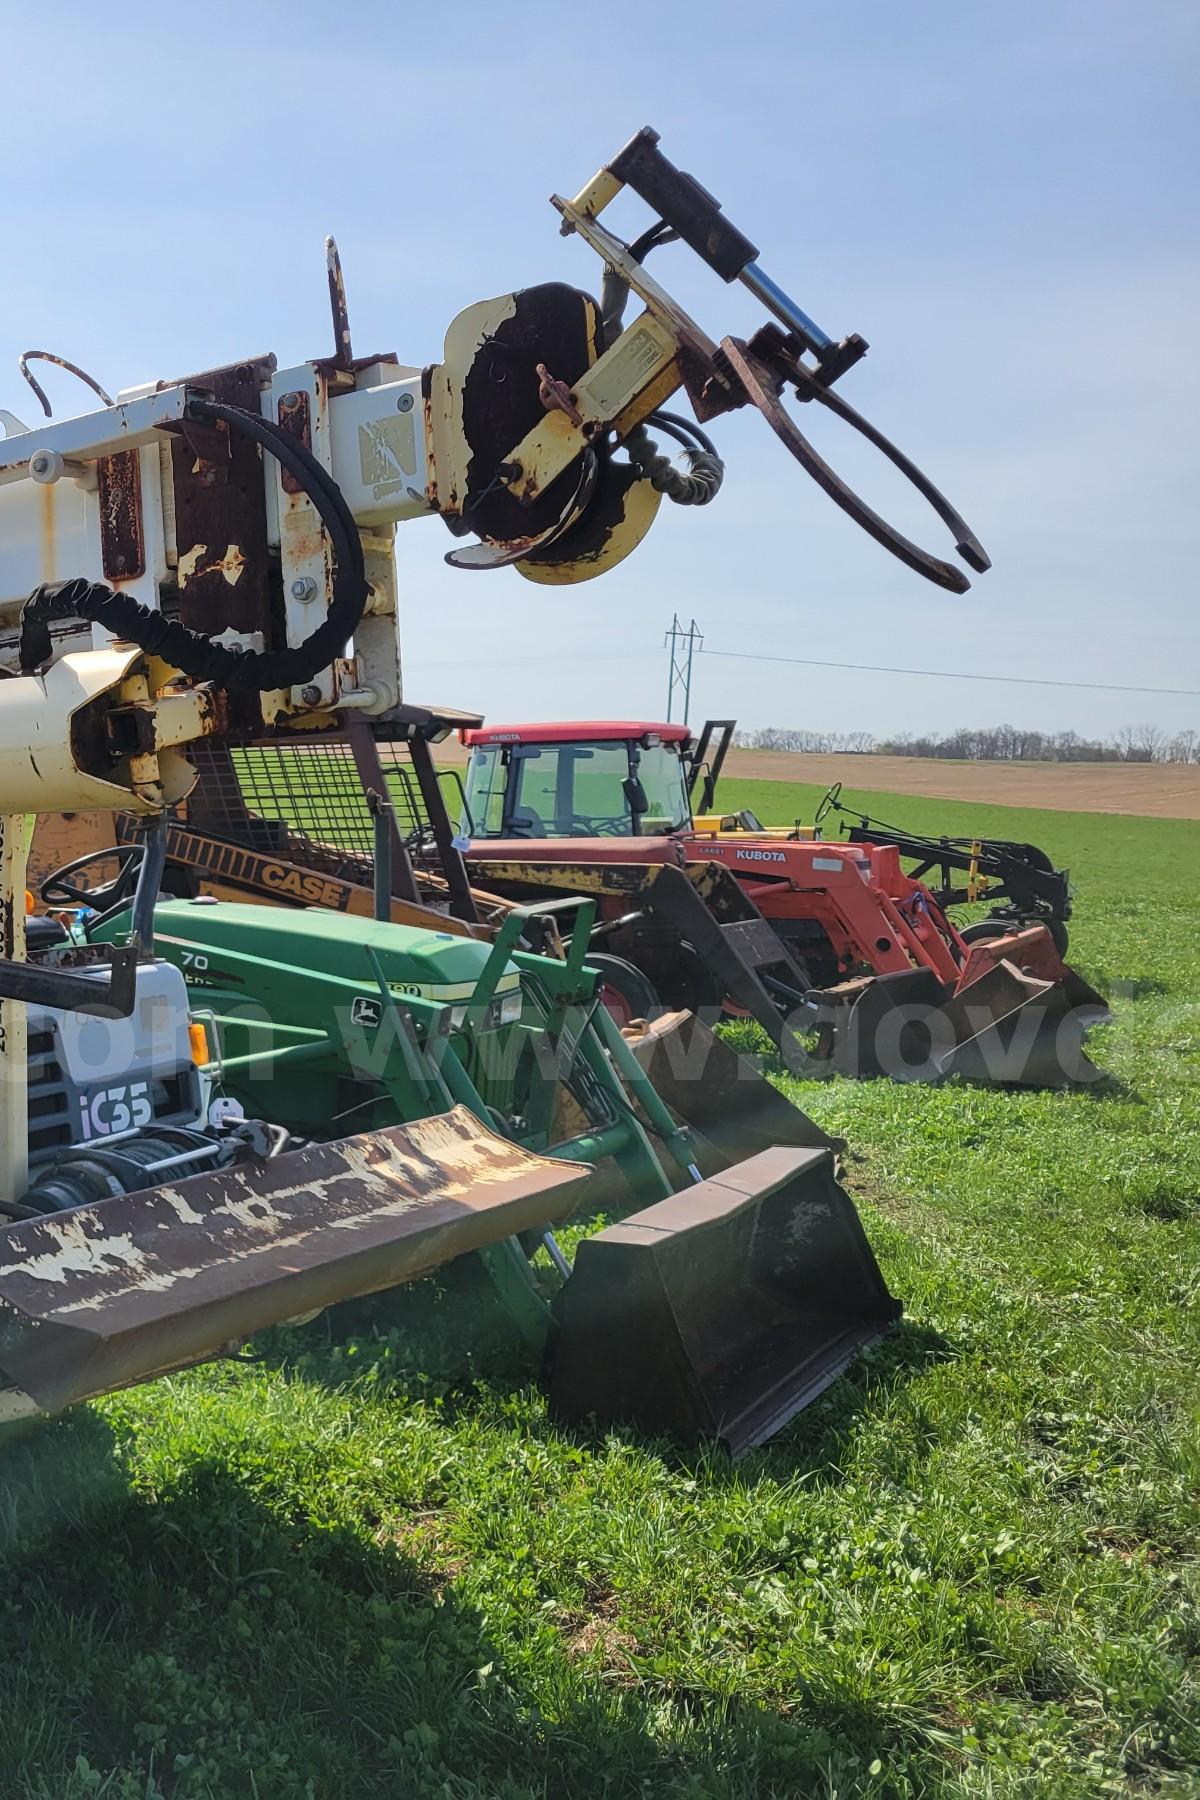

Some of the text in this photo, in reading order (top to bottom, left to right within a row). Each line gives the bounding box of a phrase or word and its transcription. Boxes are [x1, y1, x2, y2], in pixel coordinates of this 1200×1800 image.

[736, 849, 787, 863] KUBOTA
[261, 864, 344, 907] CASE
[180, 951, 209, 970] 70
[387, 983, 422, 997] 90
[79, 1081, 152, 1140] iC35
